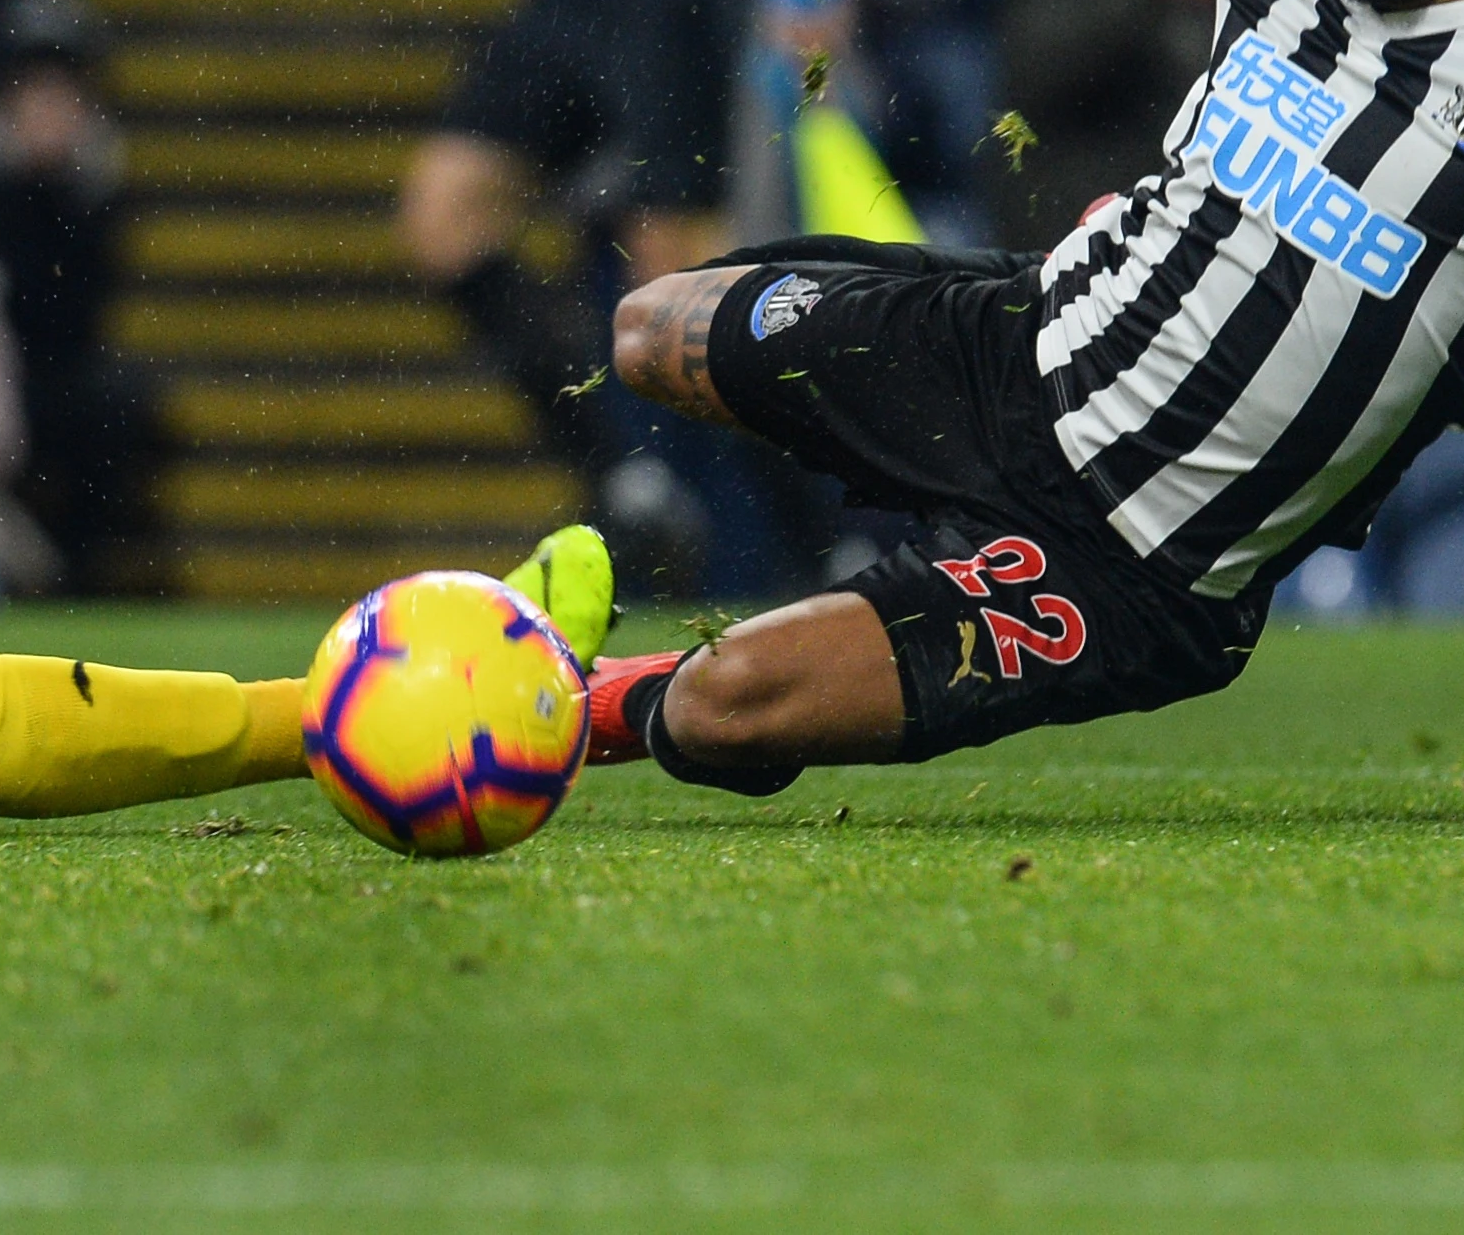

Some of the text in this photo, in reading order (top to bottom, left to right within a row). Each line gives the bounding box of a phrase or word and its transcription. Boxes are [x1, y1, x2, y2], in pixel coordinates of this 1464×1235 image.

[1215, 33, 1347, 152] 乐天堂
[1183, 95, 1425, 294] FUN88
[932, 535, 1087, 680] 22
